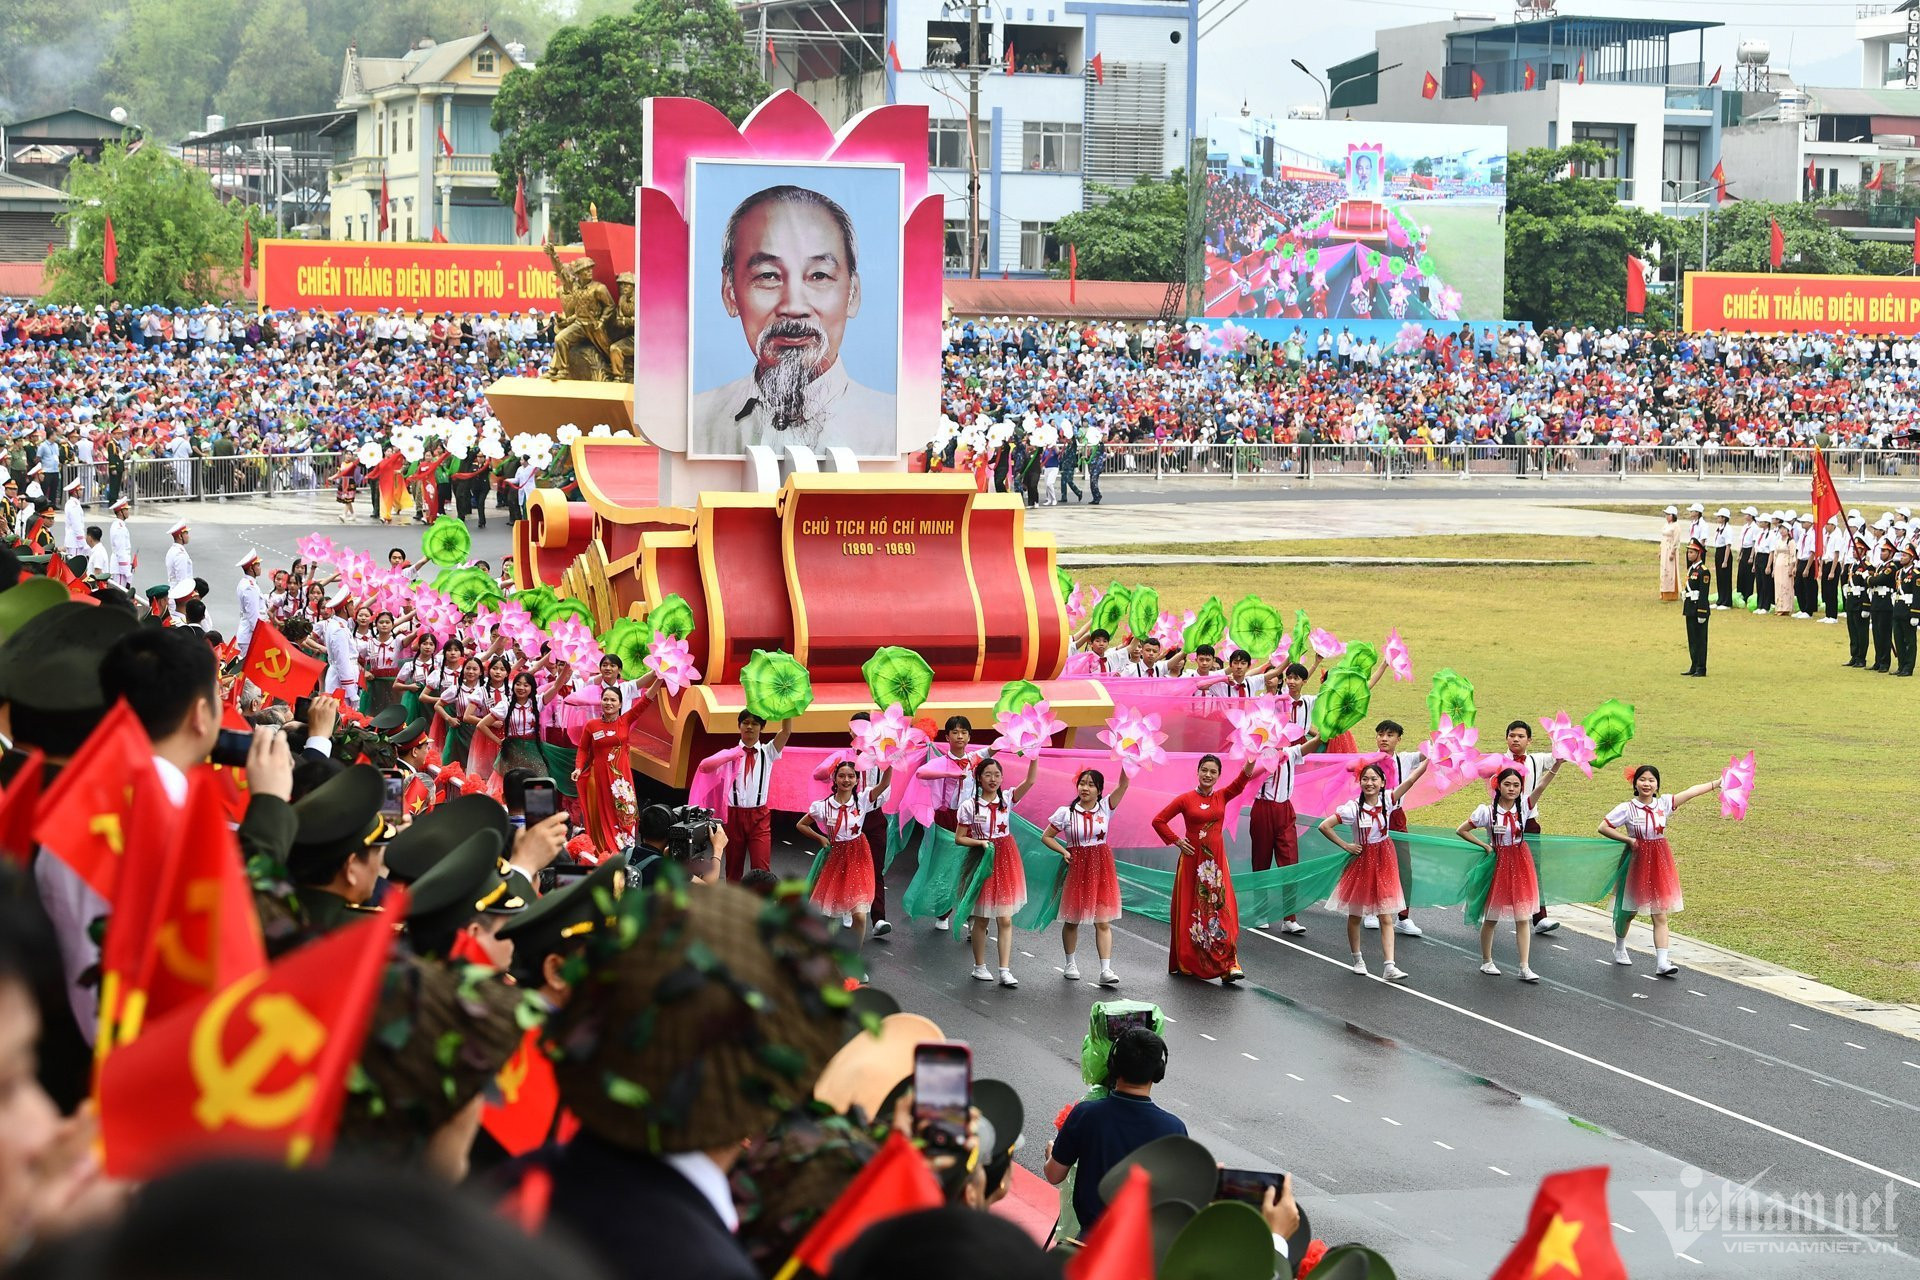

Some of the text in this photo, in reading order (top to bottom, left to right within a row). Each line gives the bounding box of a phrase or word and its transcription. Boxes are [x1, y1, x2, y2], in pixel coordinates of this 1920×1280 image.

[297, 256, 341, 297] CHIẾN
[344, 256, 392, 298] THẮNG
[396, 261, 431, 304] ĐIỆN
[435, 263, 470, 299] BIÊN
[474, 260, 503, 299] PHỦ
[518, 264, 558, 299] LỪNG
[1723, 286, 1769, 320] CHIẾN
[1773, 286, 1824, 322] THẮNG
[1828, 292, 1865, 327] ĐIỆN
[1869, 292, 1906, 323] BIÊN
[802, 515, 955, 537] CHỦ TỊCH HỒ CHÍ MINH
[842, 541, 874, 556] (1890
[885, 541, 916, 556] 1969)
